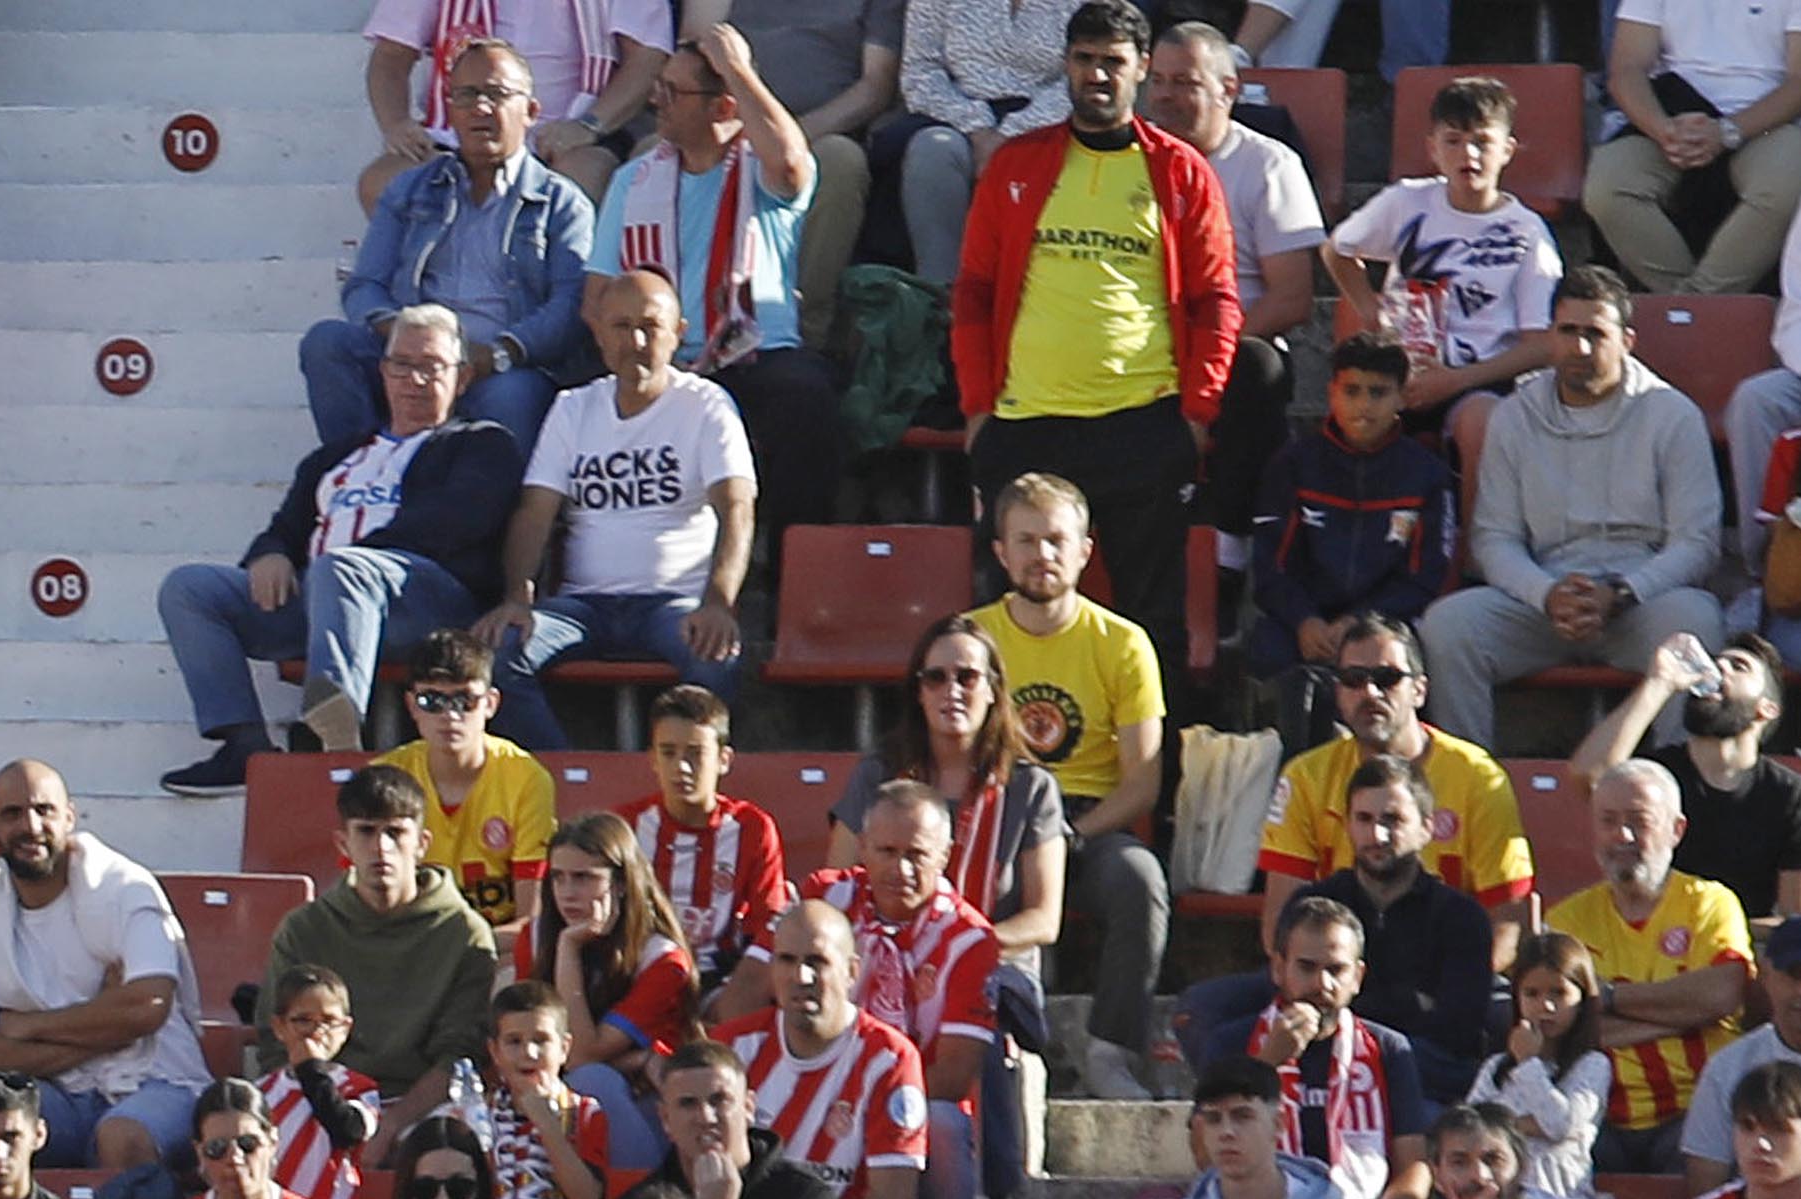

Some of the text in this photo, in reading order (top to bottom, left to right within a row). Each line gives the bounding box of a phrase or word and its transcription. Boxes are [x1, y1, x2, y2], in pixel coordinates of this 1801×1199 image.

[171, 128, 207, 158] 10
[104, 353, 146, 382] 09
[570, 477, 682, 508] JONES
[38, 575, 82, 602] 08
